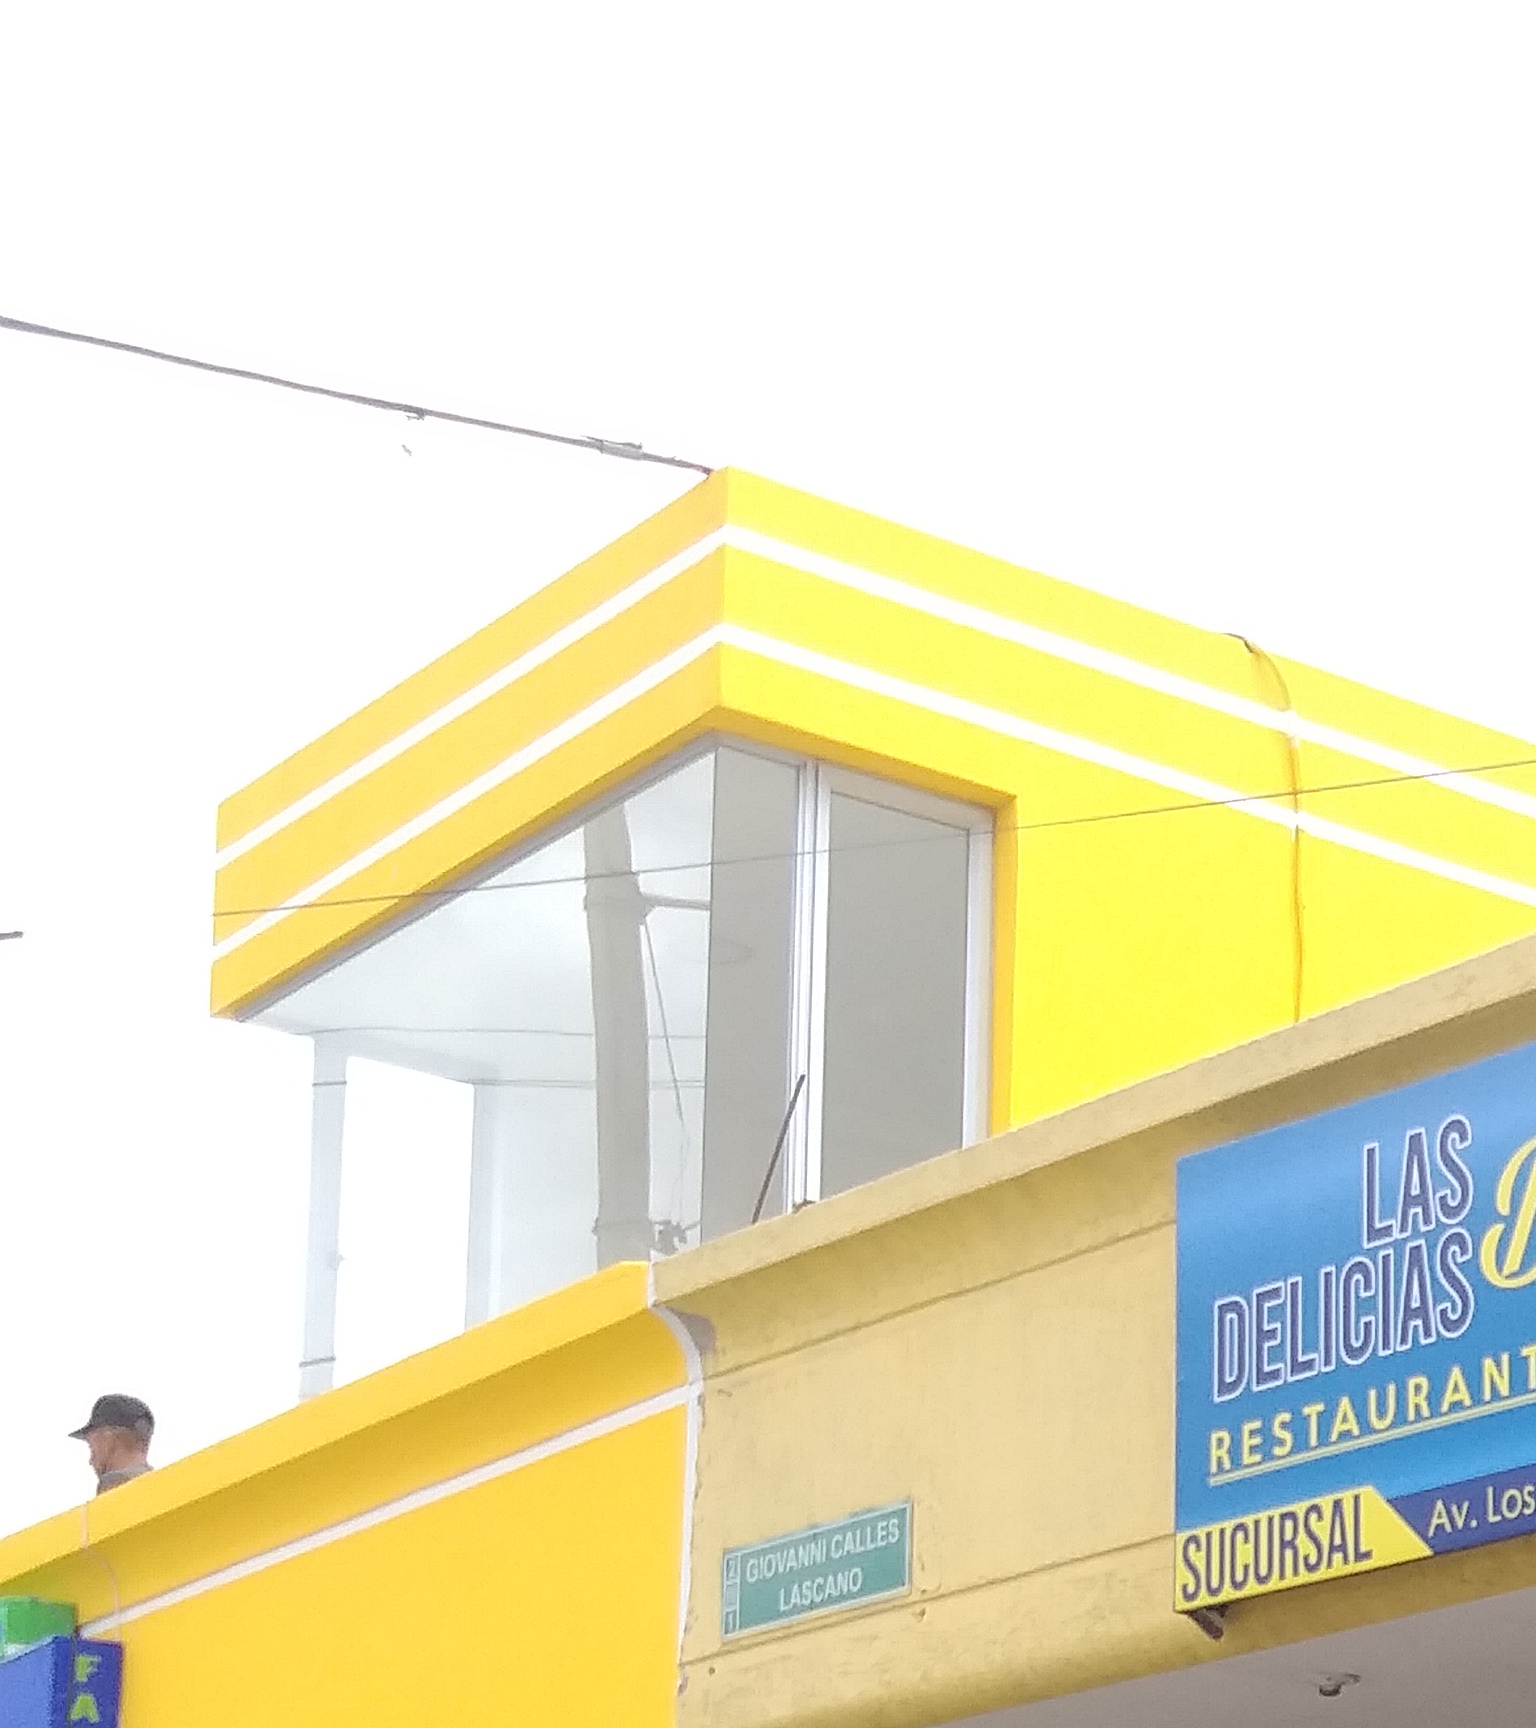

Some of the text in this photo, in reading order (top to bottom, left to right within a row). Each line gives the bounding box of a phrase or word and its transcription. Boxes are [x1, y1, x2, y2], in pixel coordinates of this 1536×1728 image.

[1363, 1113, 1473, 1249] LAS
[1211, 1228, 1475, 1403] DELICIAS
[746, 1518, 900, 1583] GIOVANNI CALLES
[1181, 1495, 1374, 1602] SUCURSAL
[1428, 1499, 1477, 1537] Av.
[1486, 1483, 1535, 1522] Los
[779, 1568, 863, 1611] LASCANO
